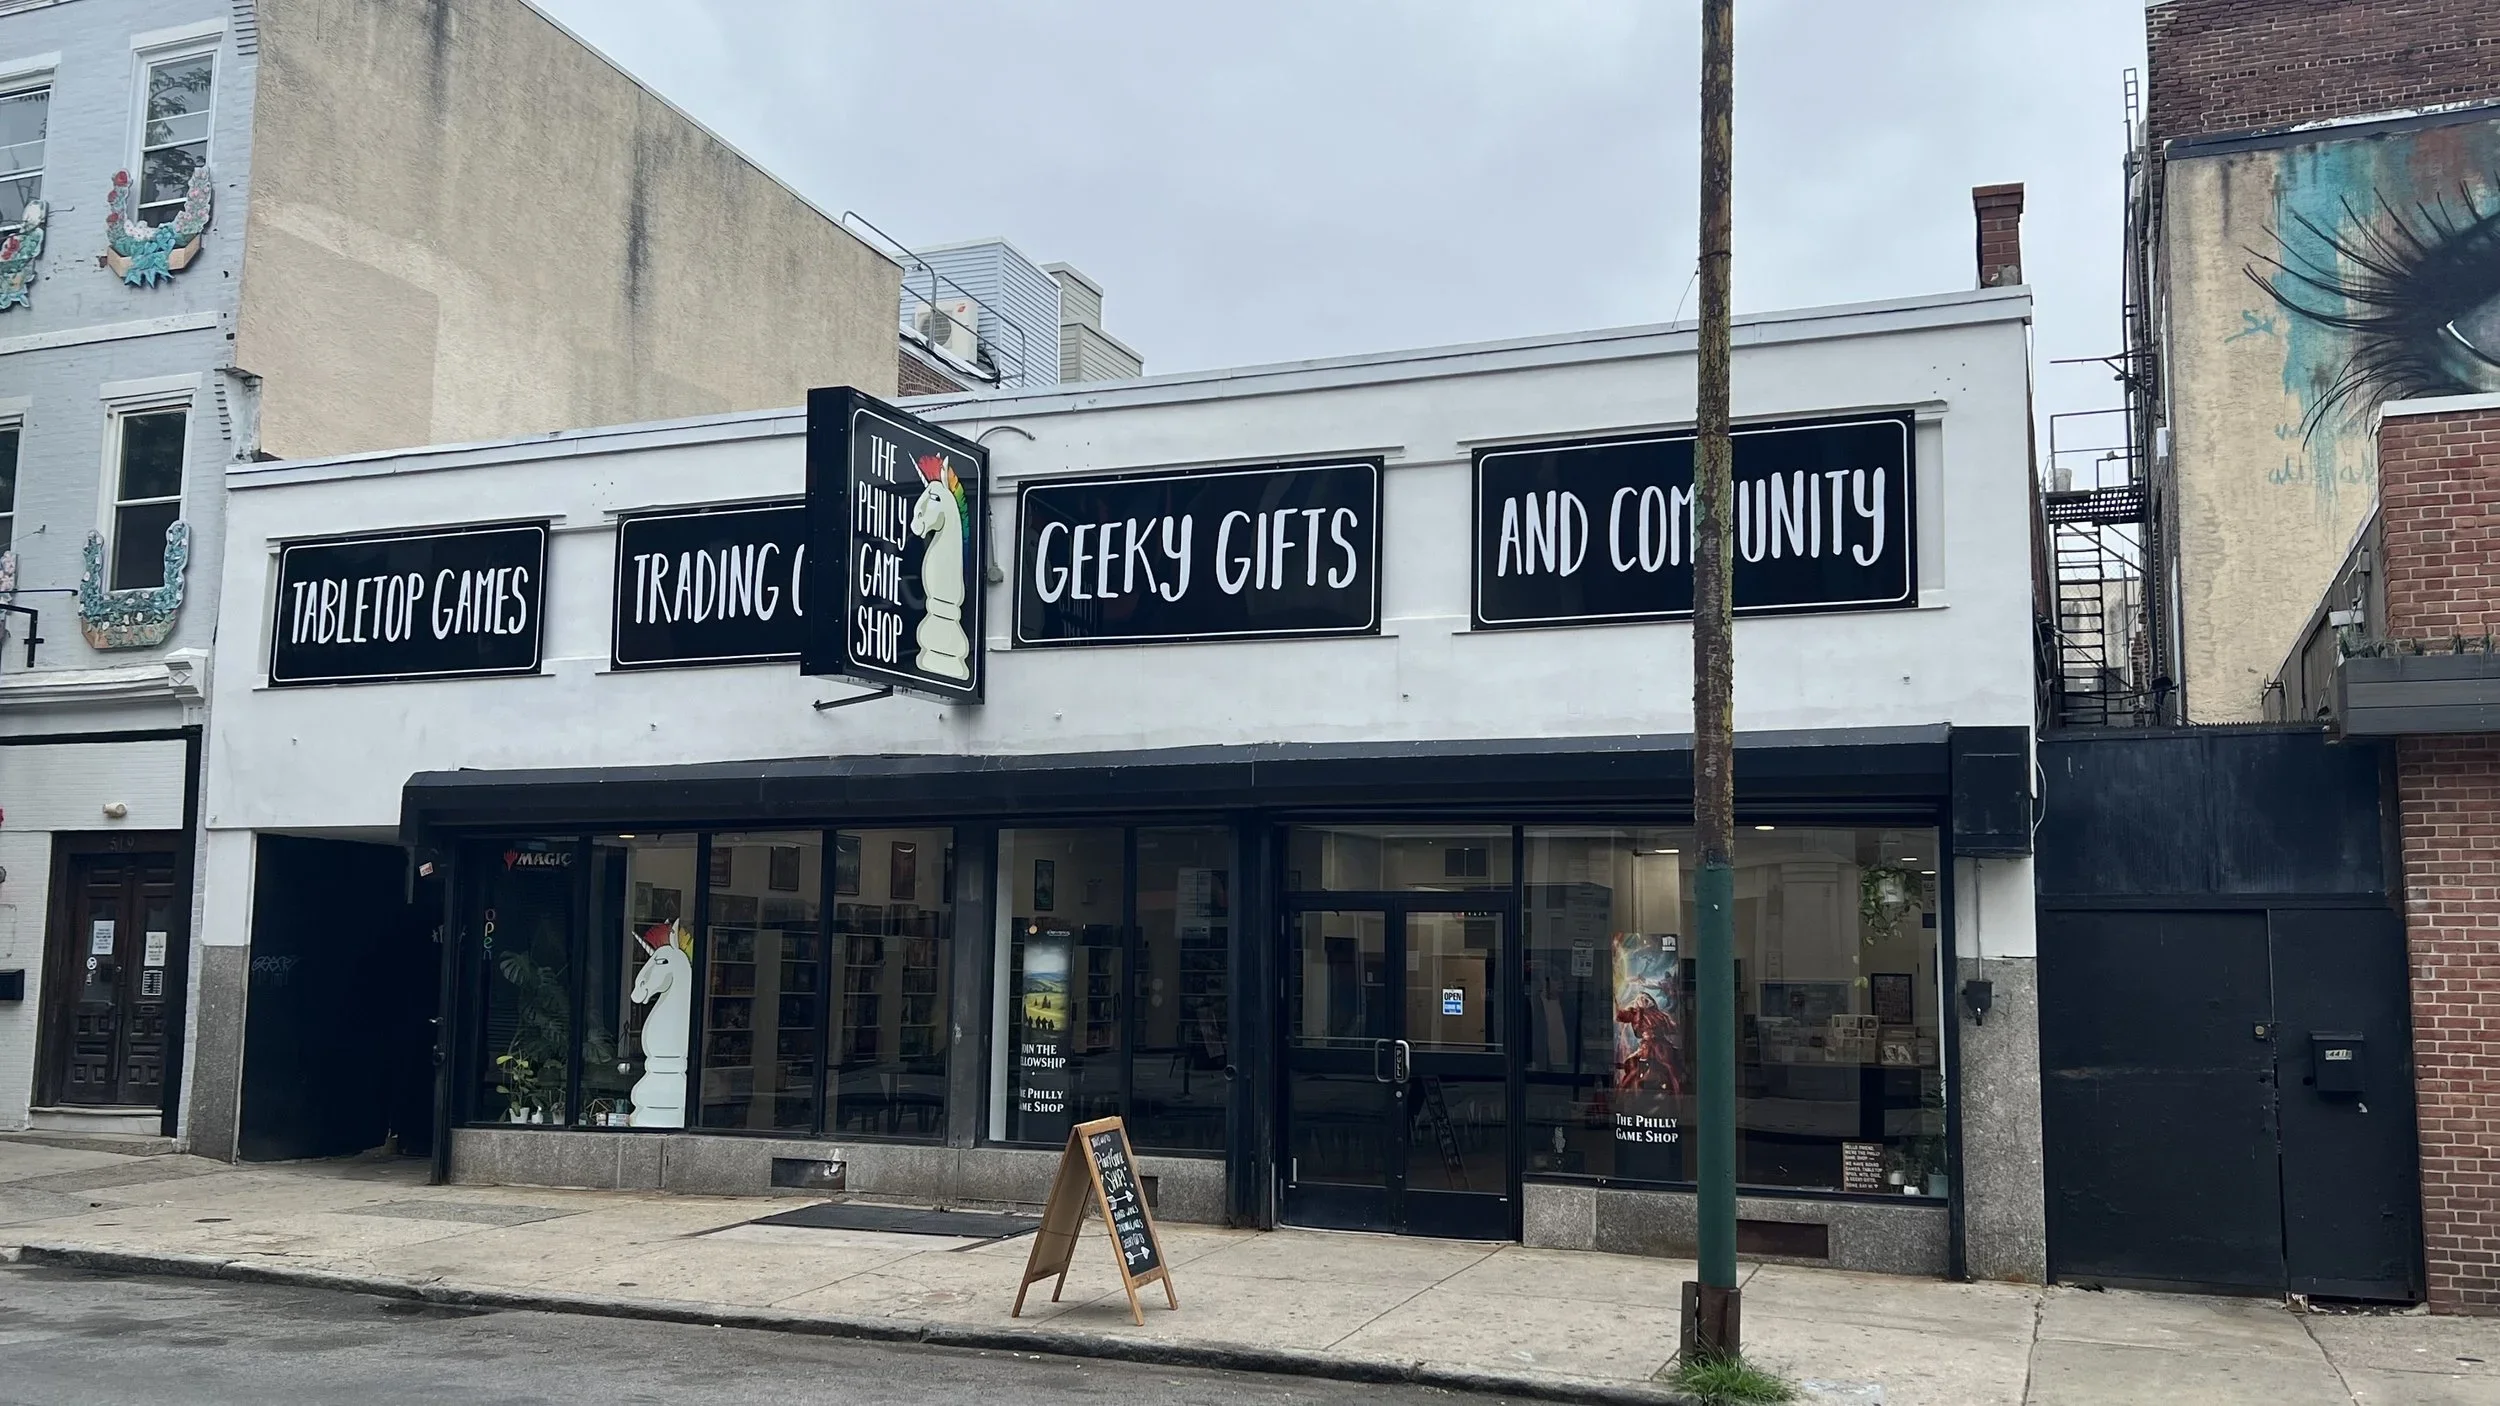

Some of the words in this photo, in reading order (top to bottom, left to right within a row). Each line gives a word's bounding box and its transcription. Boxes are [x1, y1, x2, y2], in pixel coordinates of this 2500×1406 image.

[871, 434, 898, 485] THE
[858, 480, 907, 552] PHILLY
[1496, 489, 1589, 578] AND
[1608, 467, 1885, 573] COMUNITY
[859, 542, 903, 607] GAME
[1035, 513, 1193, 604] GEEKY
[1215, 507, 1358, 596] GIFTS
[291, 572, 424, 645] TABLETOP
[432, 566, 529, 640] GAMES
[634, 542, 780, 624] TRADING
[856, 606, 903, 664] SHOP
[516, 852, 572, 867] MAGIC
[1444, 992, 1461, 1001] OPEN
[1036, 1044, 1057, 1056] THE
[1028, 1087, 1063, 1099] PHILLY
[1034, 1101, 1064, 1113] SHOP
[1615, 1113, 1633, 1127] THE
[1636, 1114, 1677, 1128] PHILLY
[1615, 1127, 1643, 1142] GAME
[1645, 1130, 1679, 1143] SHOP
